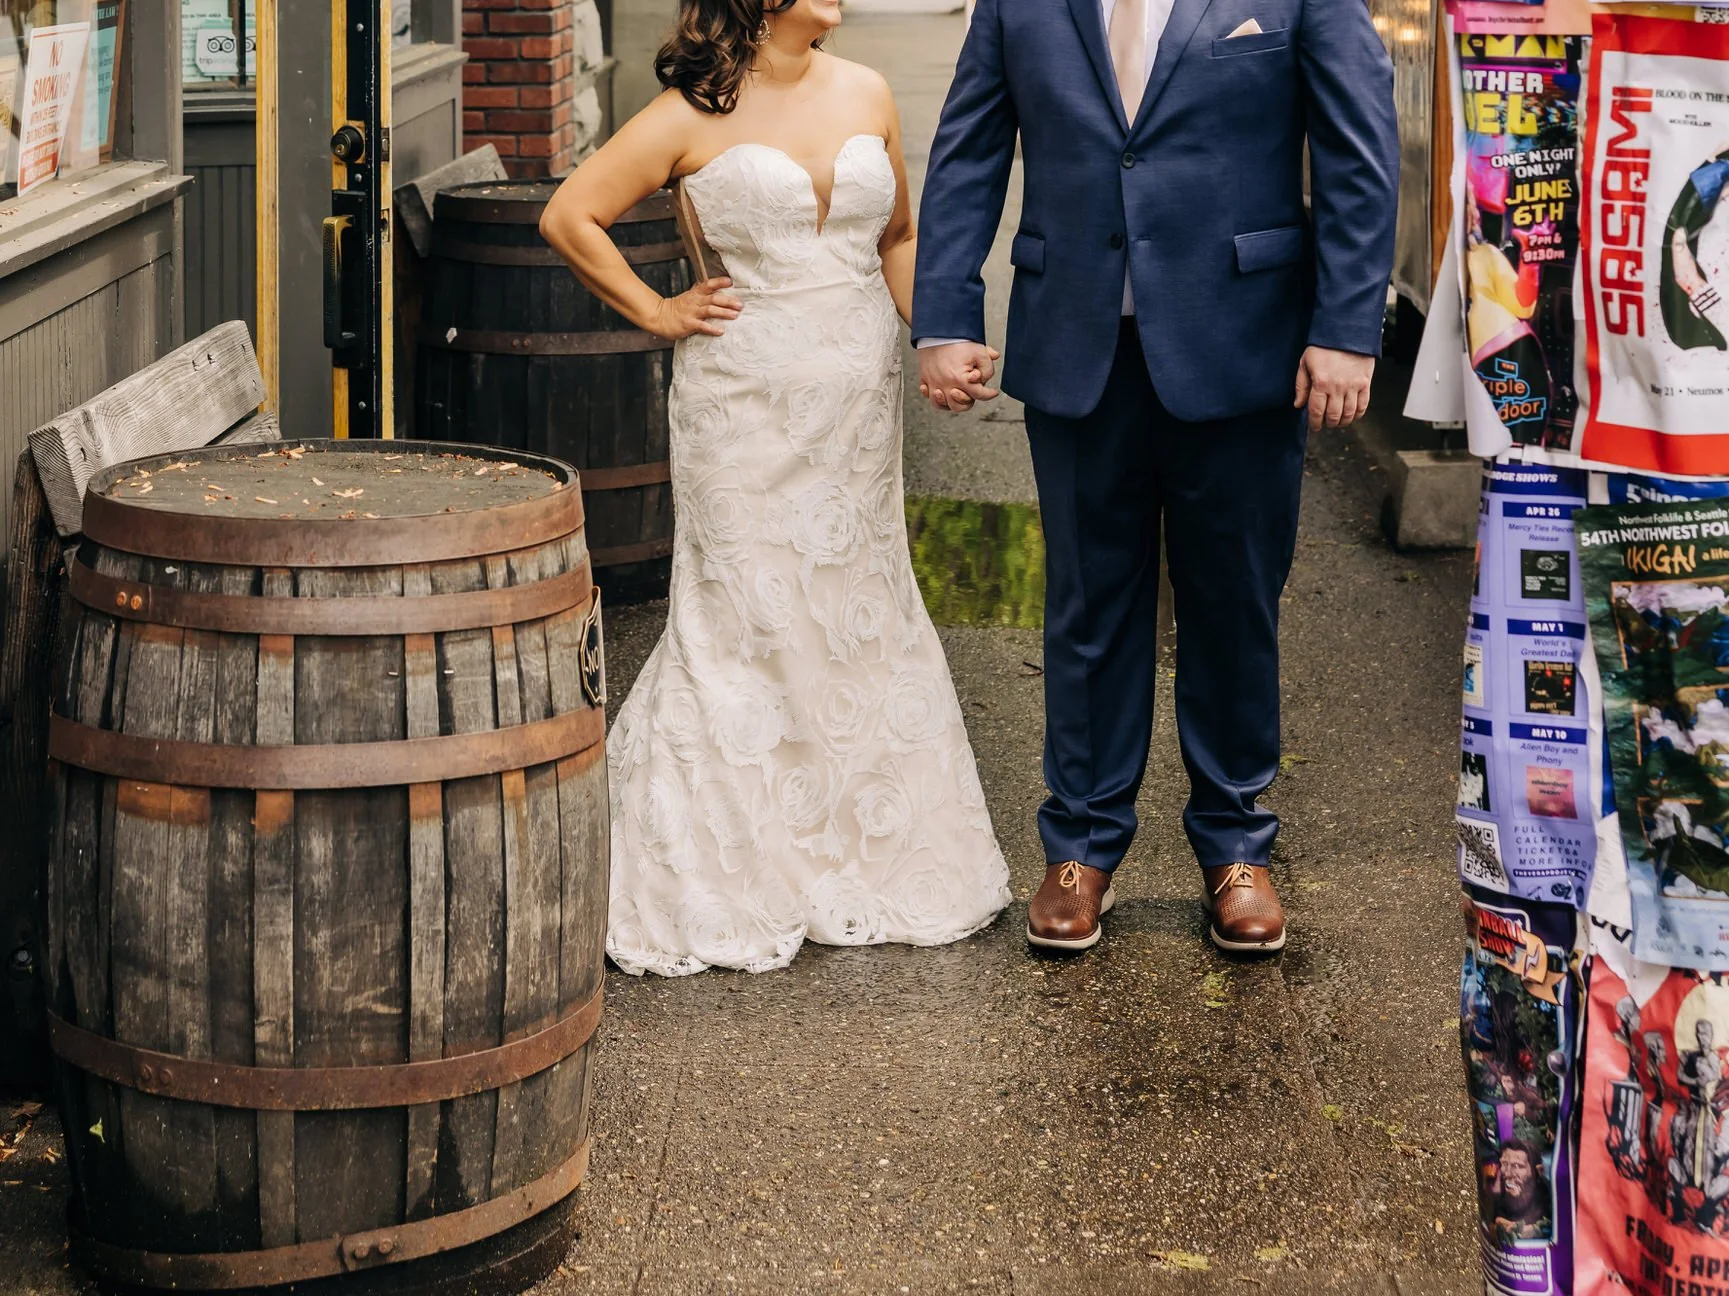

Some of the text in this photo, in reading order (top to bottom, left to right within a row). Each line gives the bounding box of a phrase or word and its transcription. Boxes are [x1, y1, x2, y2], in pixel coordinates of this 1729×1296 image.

[49, 40, 65, 68] NO
[32, 72, 71, 106] SMOKING
[1655, 88, 1725, 103] BLOOD ON THE
[1490, 148, 1575, 168] ONE NIGHT
[1515, 163, 1561, 178] ONLY!
[1504, 179, 1572, 205] JUNE
[1513, 201, 1565, 226] 6TH
[1600, 86, 1654, 338] SASAMI
[1498, 400, 1541, 421] door
[1516, 473, 1558, 483] SHOWS
[1526, 506, 1546, 515] APR
[1654, 512, 1684, 523] Folklife
[1684, 511, 1693, 521] &
[1694, 508, 1728, 521] Seattle
[1581, 530, 1620, 547] 54TH
[1621, 524, 1699, 542] NORTHWEST
[1626, 543, 1697, 575] IKIGAI
[1702, 551, 1710, 561] a
[1532, 622, 1556, 632] MAY
[1520, 648, 1558, 657] Greatest
[1531, 728, 1554, 738] MAY
[1562, 746, 1579, 755] and
[1514, 825, 1545, 834] FULL
[1516, 836, 1582, 847] CALENDAR
[1519, 857, 1553, 865] MORE
